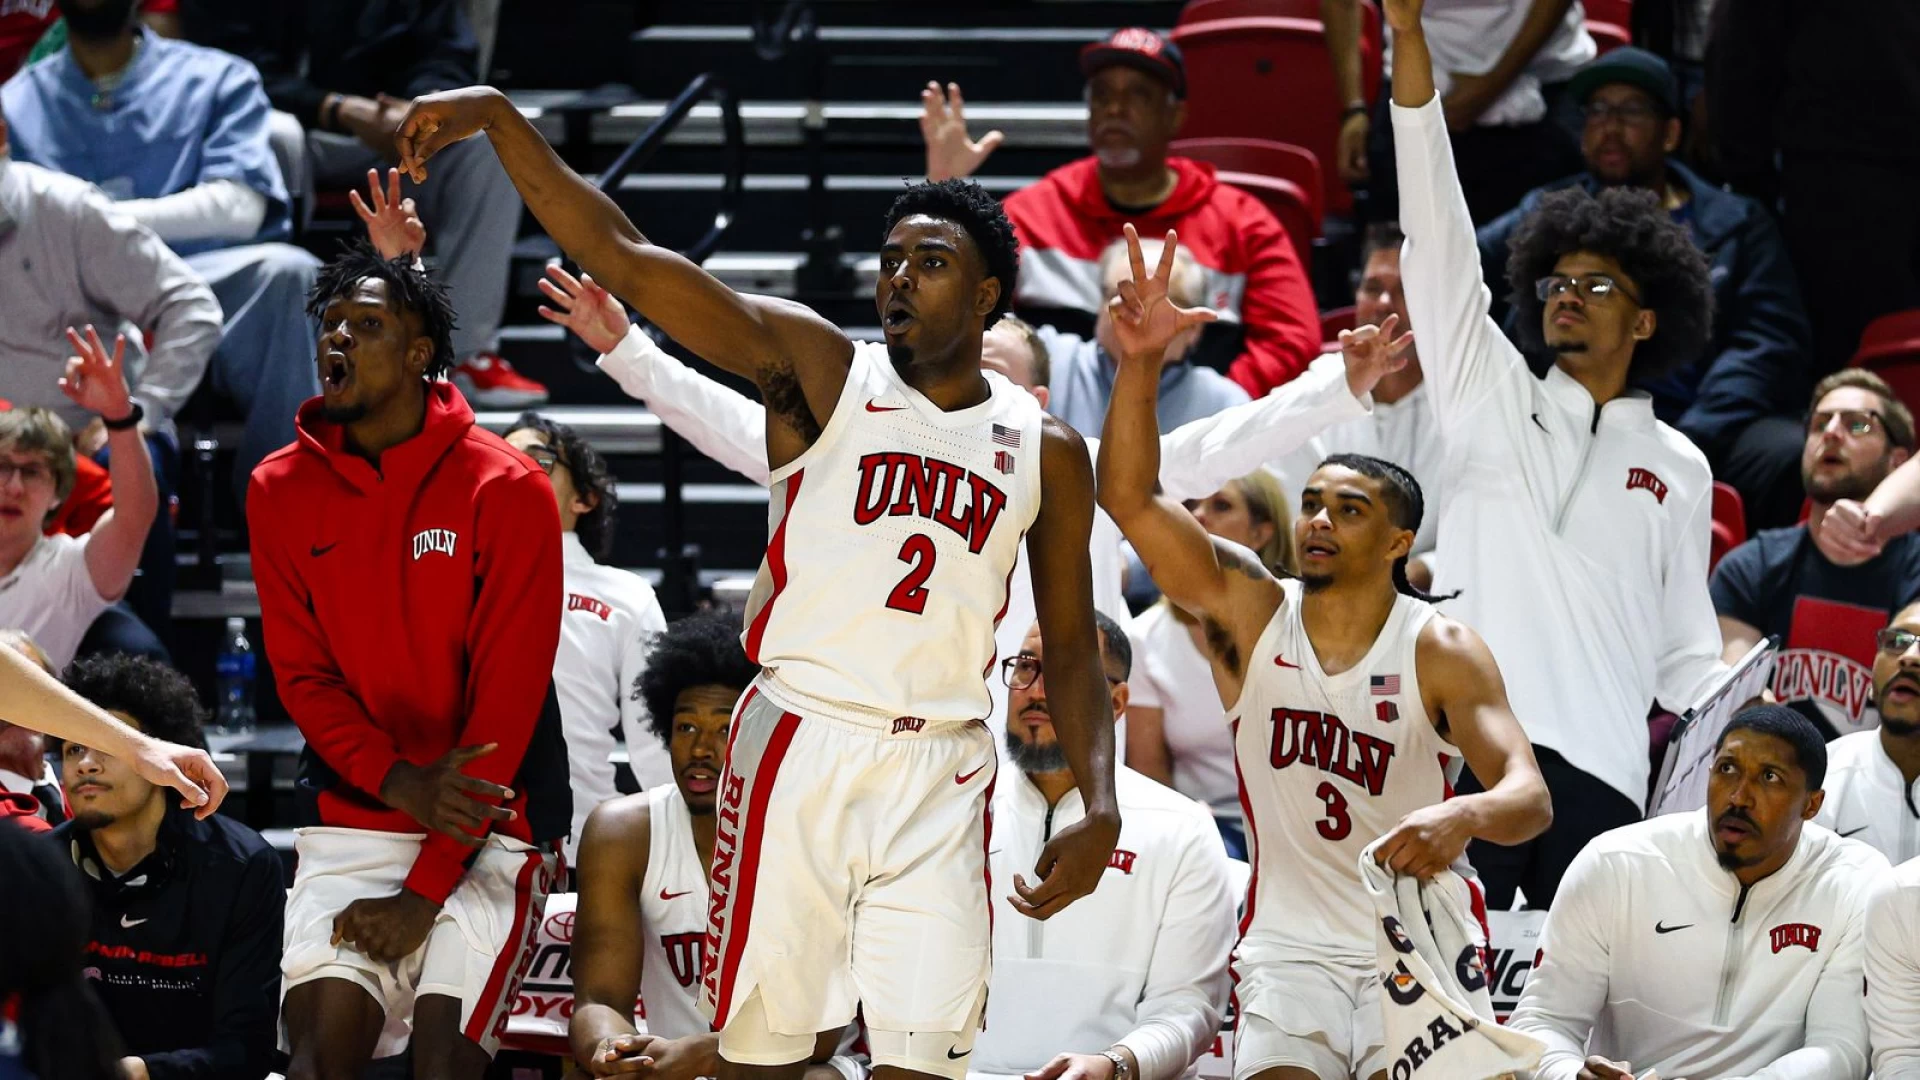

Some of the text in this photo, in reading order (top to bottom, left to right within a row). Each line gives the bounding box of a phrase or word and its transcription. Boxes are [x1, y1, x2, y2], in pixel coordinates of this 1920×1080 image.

[854, 452, 1007, 555] UNLV
[1626, 467, 1668, 505] UNLV
[413, 528, 457, 561] UNLV
[885, 533, 936, 615] 2
[567, 593, 612, 621] UNLV
[1773, 650, 1873, 723] UNLV
[891, 716, 926, 735] UNLV
[1269, 707, 1396, 796] UNLV
[1315, 781, 1352, 841] 3
[1769, 923, 1821, 954] UNLV
